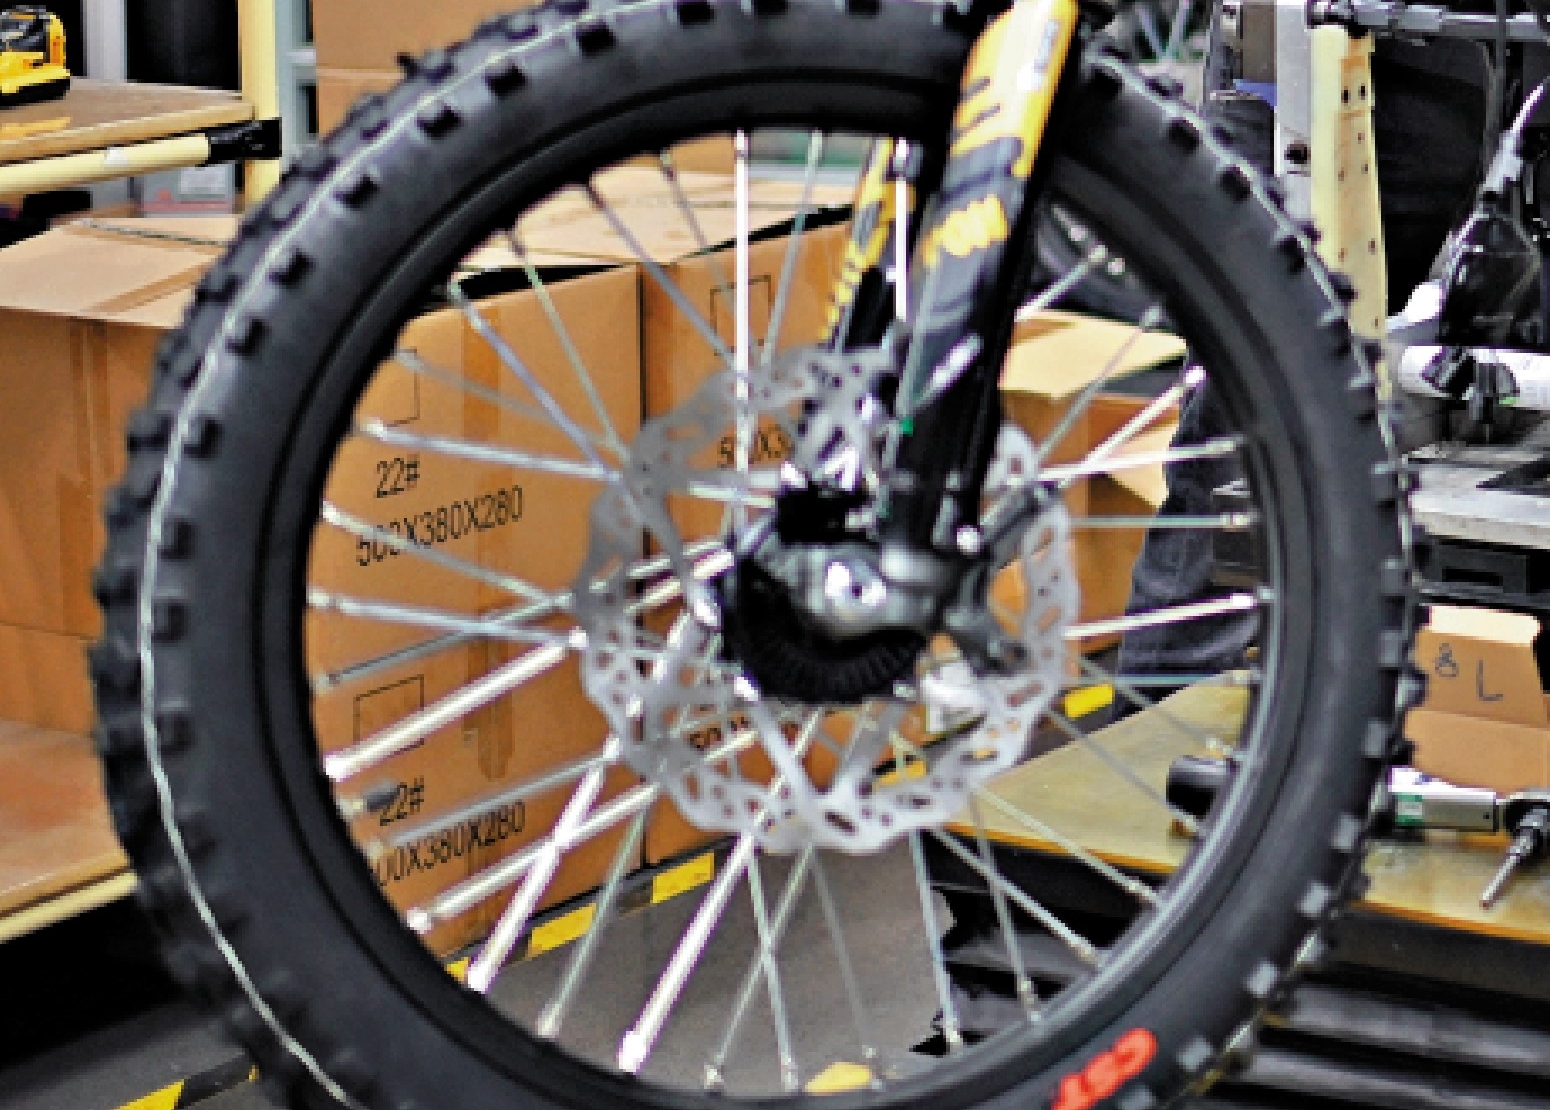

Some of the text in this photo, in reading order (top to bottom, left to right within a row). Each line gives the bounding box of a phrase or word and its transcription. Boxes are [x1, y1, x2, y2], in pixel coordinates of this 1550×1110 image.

[374, 454, 420, 498] 22#
[1476, 659, 1503, 701] L
[377, 799, 525, 887] 00X380X280
